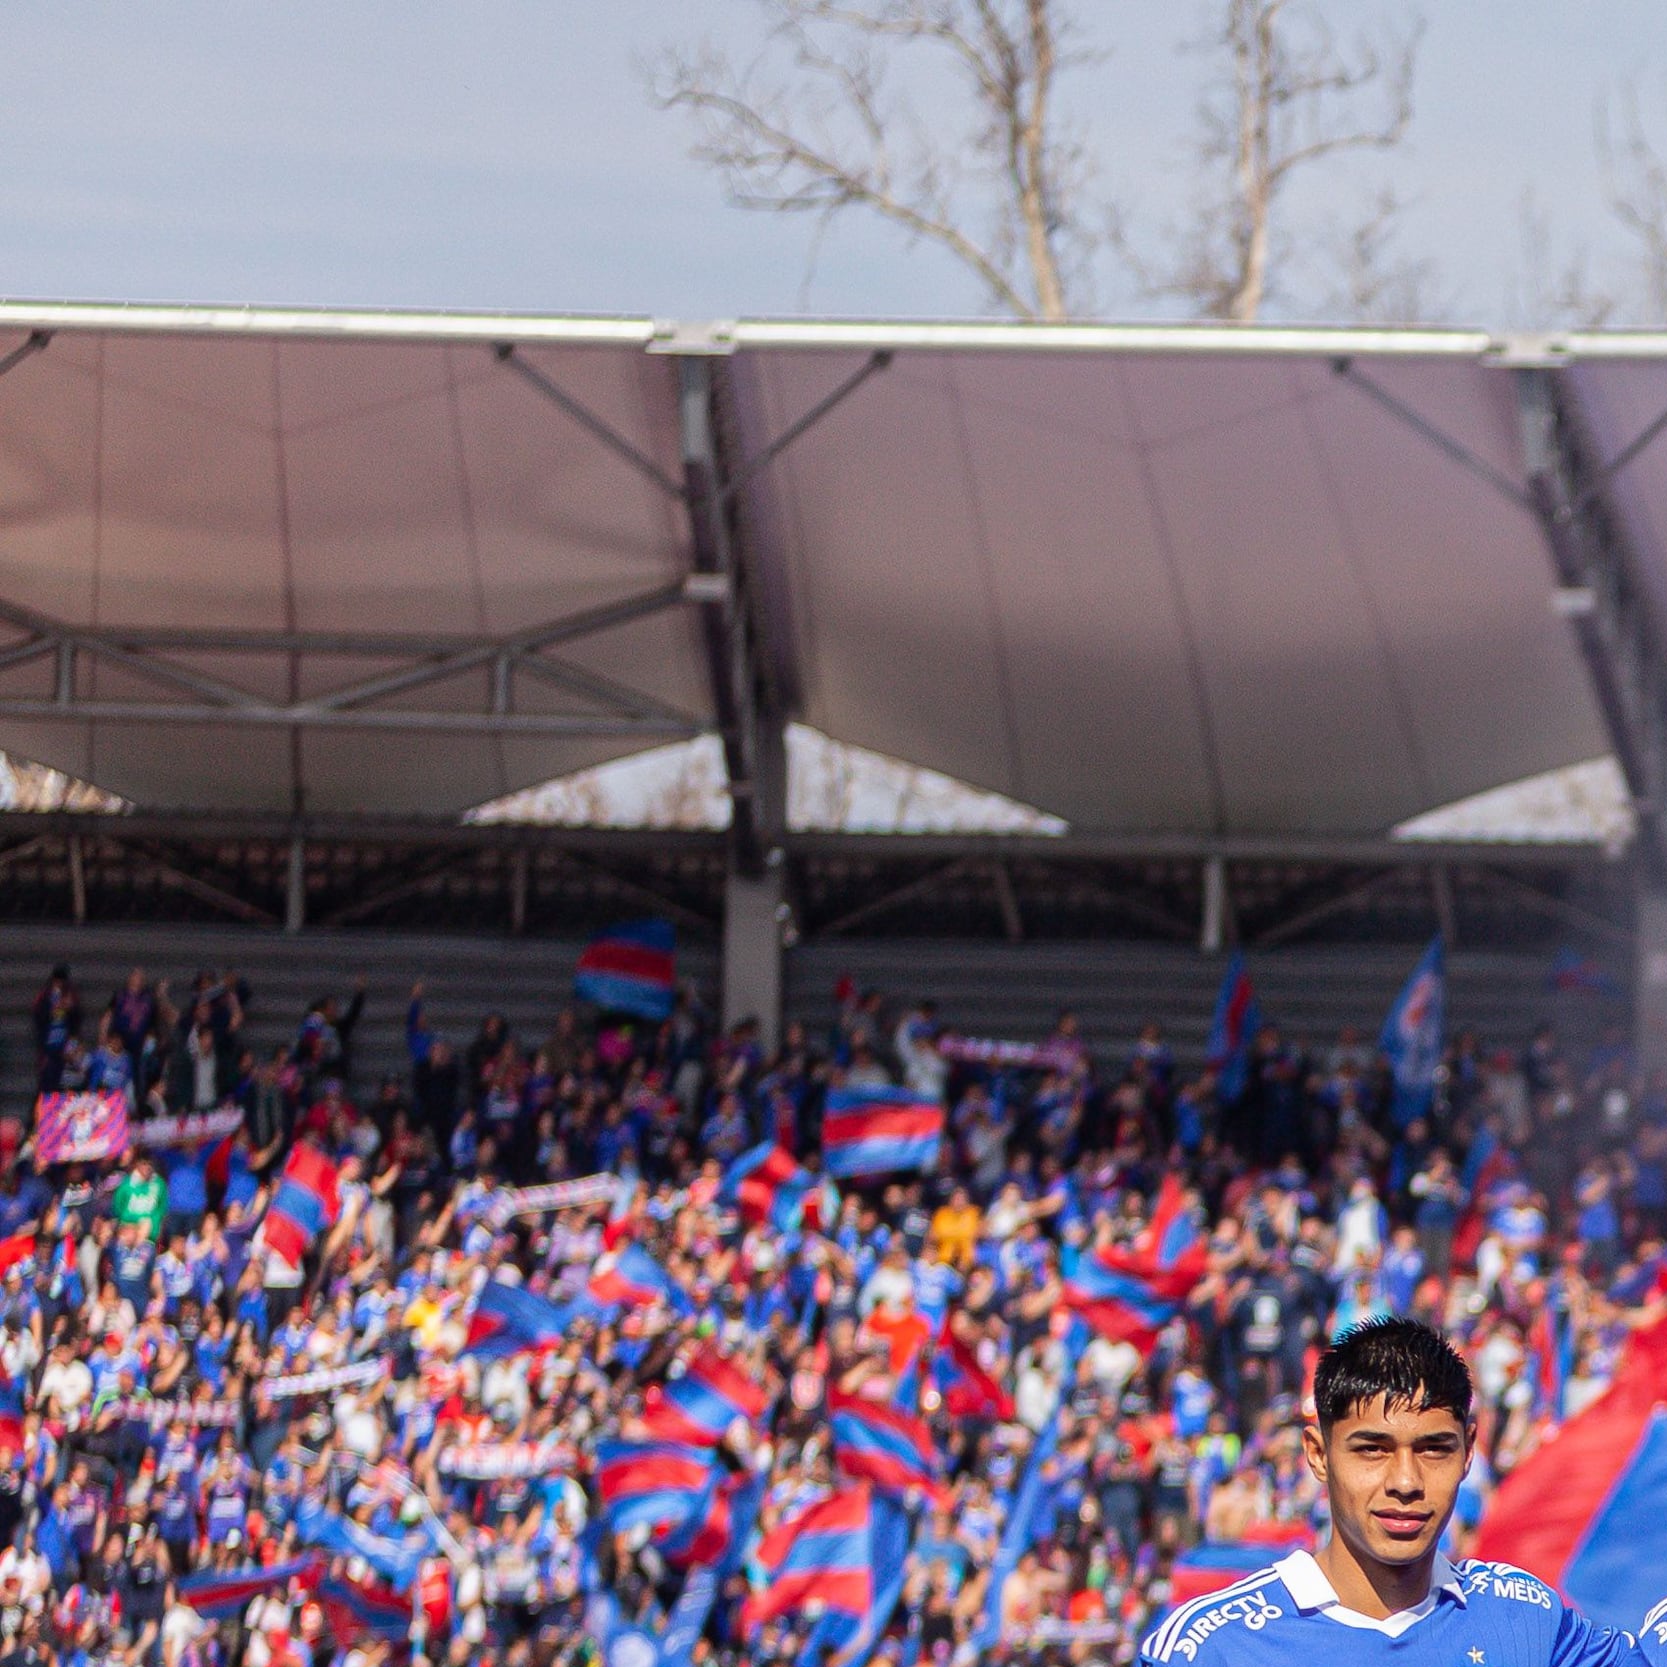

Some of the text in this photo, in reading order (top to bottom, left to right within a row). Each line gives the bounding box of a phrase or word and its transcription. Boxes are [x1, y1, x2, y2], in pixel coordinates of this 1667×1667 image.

[1494, 1578, 1552, 1610] MEDS
[1174, 1590, 1268, 1662] DIRECTV
[1243, 1603, 1283, 1631] GO
